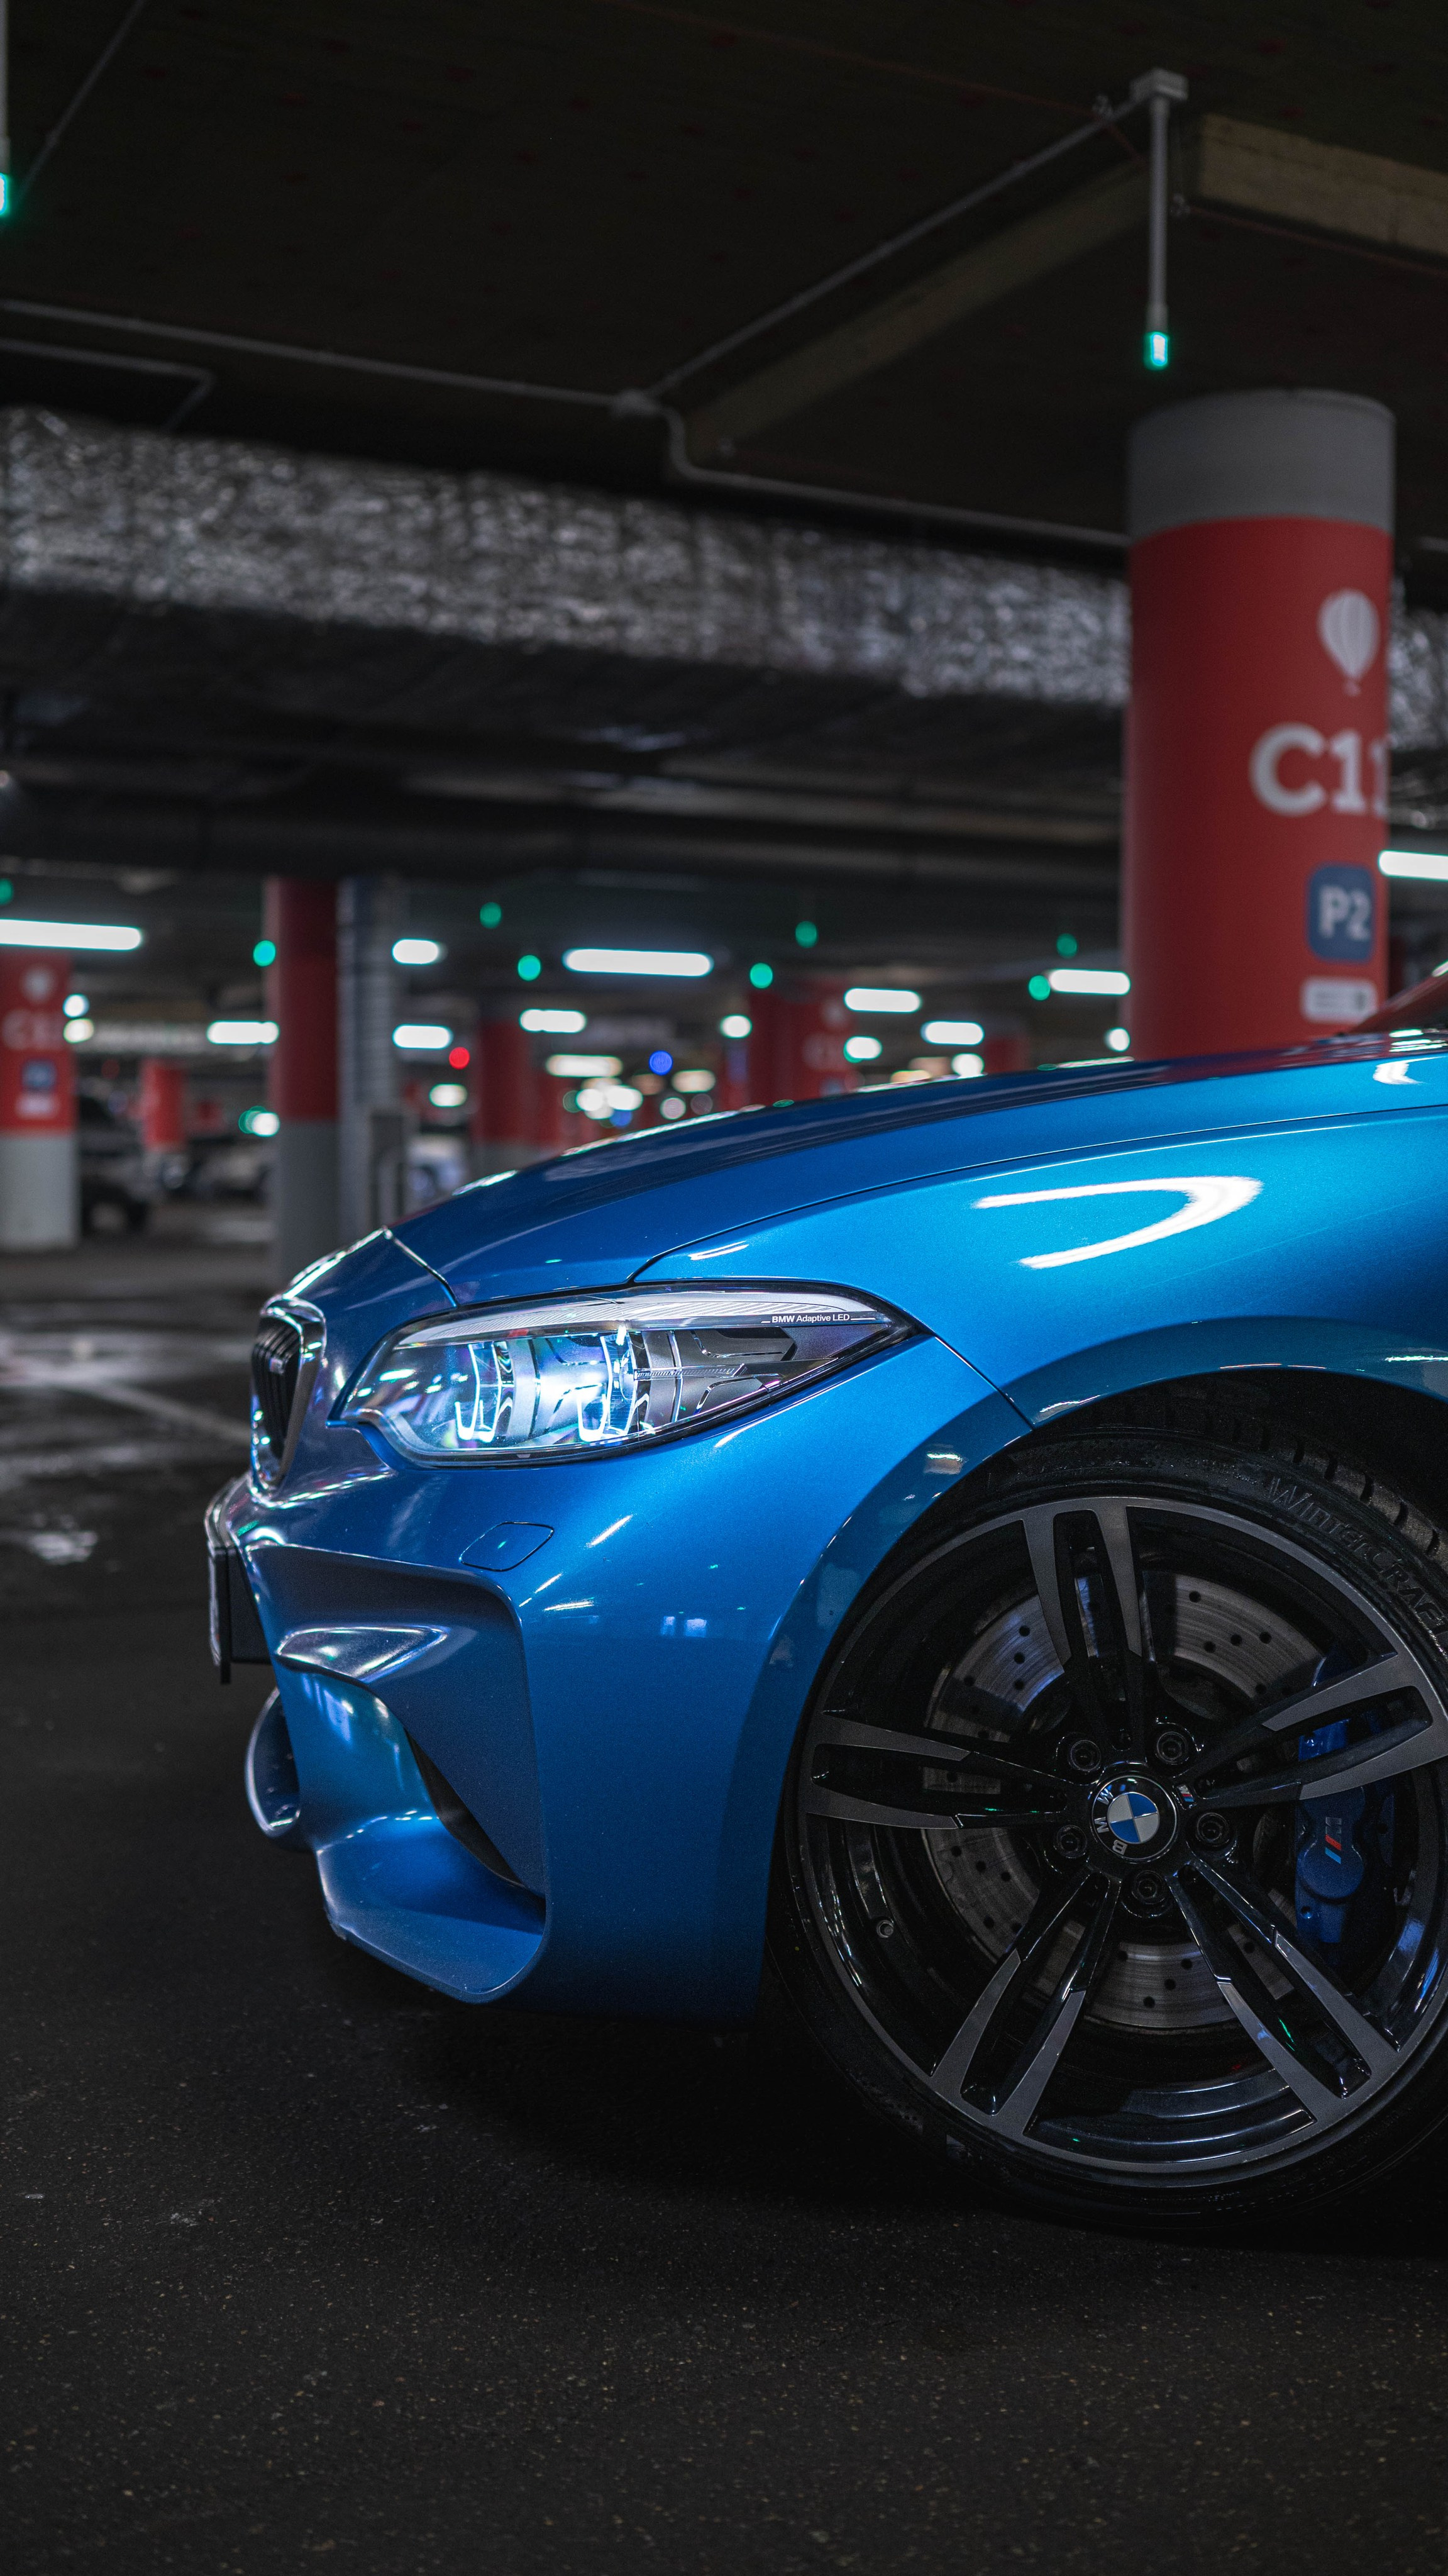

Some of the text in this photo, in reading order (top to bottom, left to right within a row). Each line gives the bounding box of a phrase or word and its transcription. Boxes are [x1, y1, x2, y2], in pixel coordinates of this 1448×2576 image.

[1320, 886, 1371, 941] P2
[771, 1313, 850, 1323] BMW Adaptive LED
[1093, 1787, 1129, 1856] BMW
